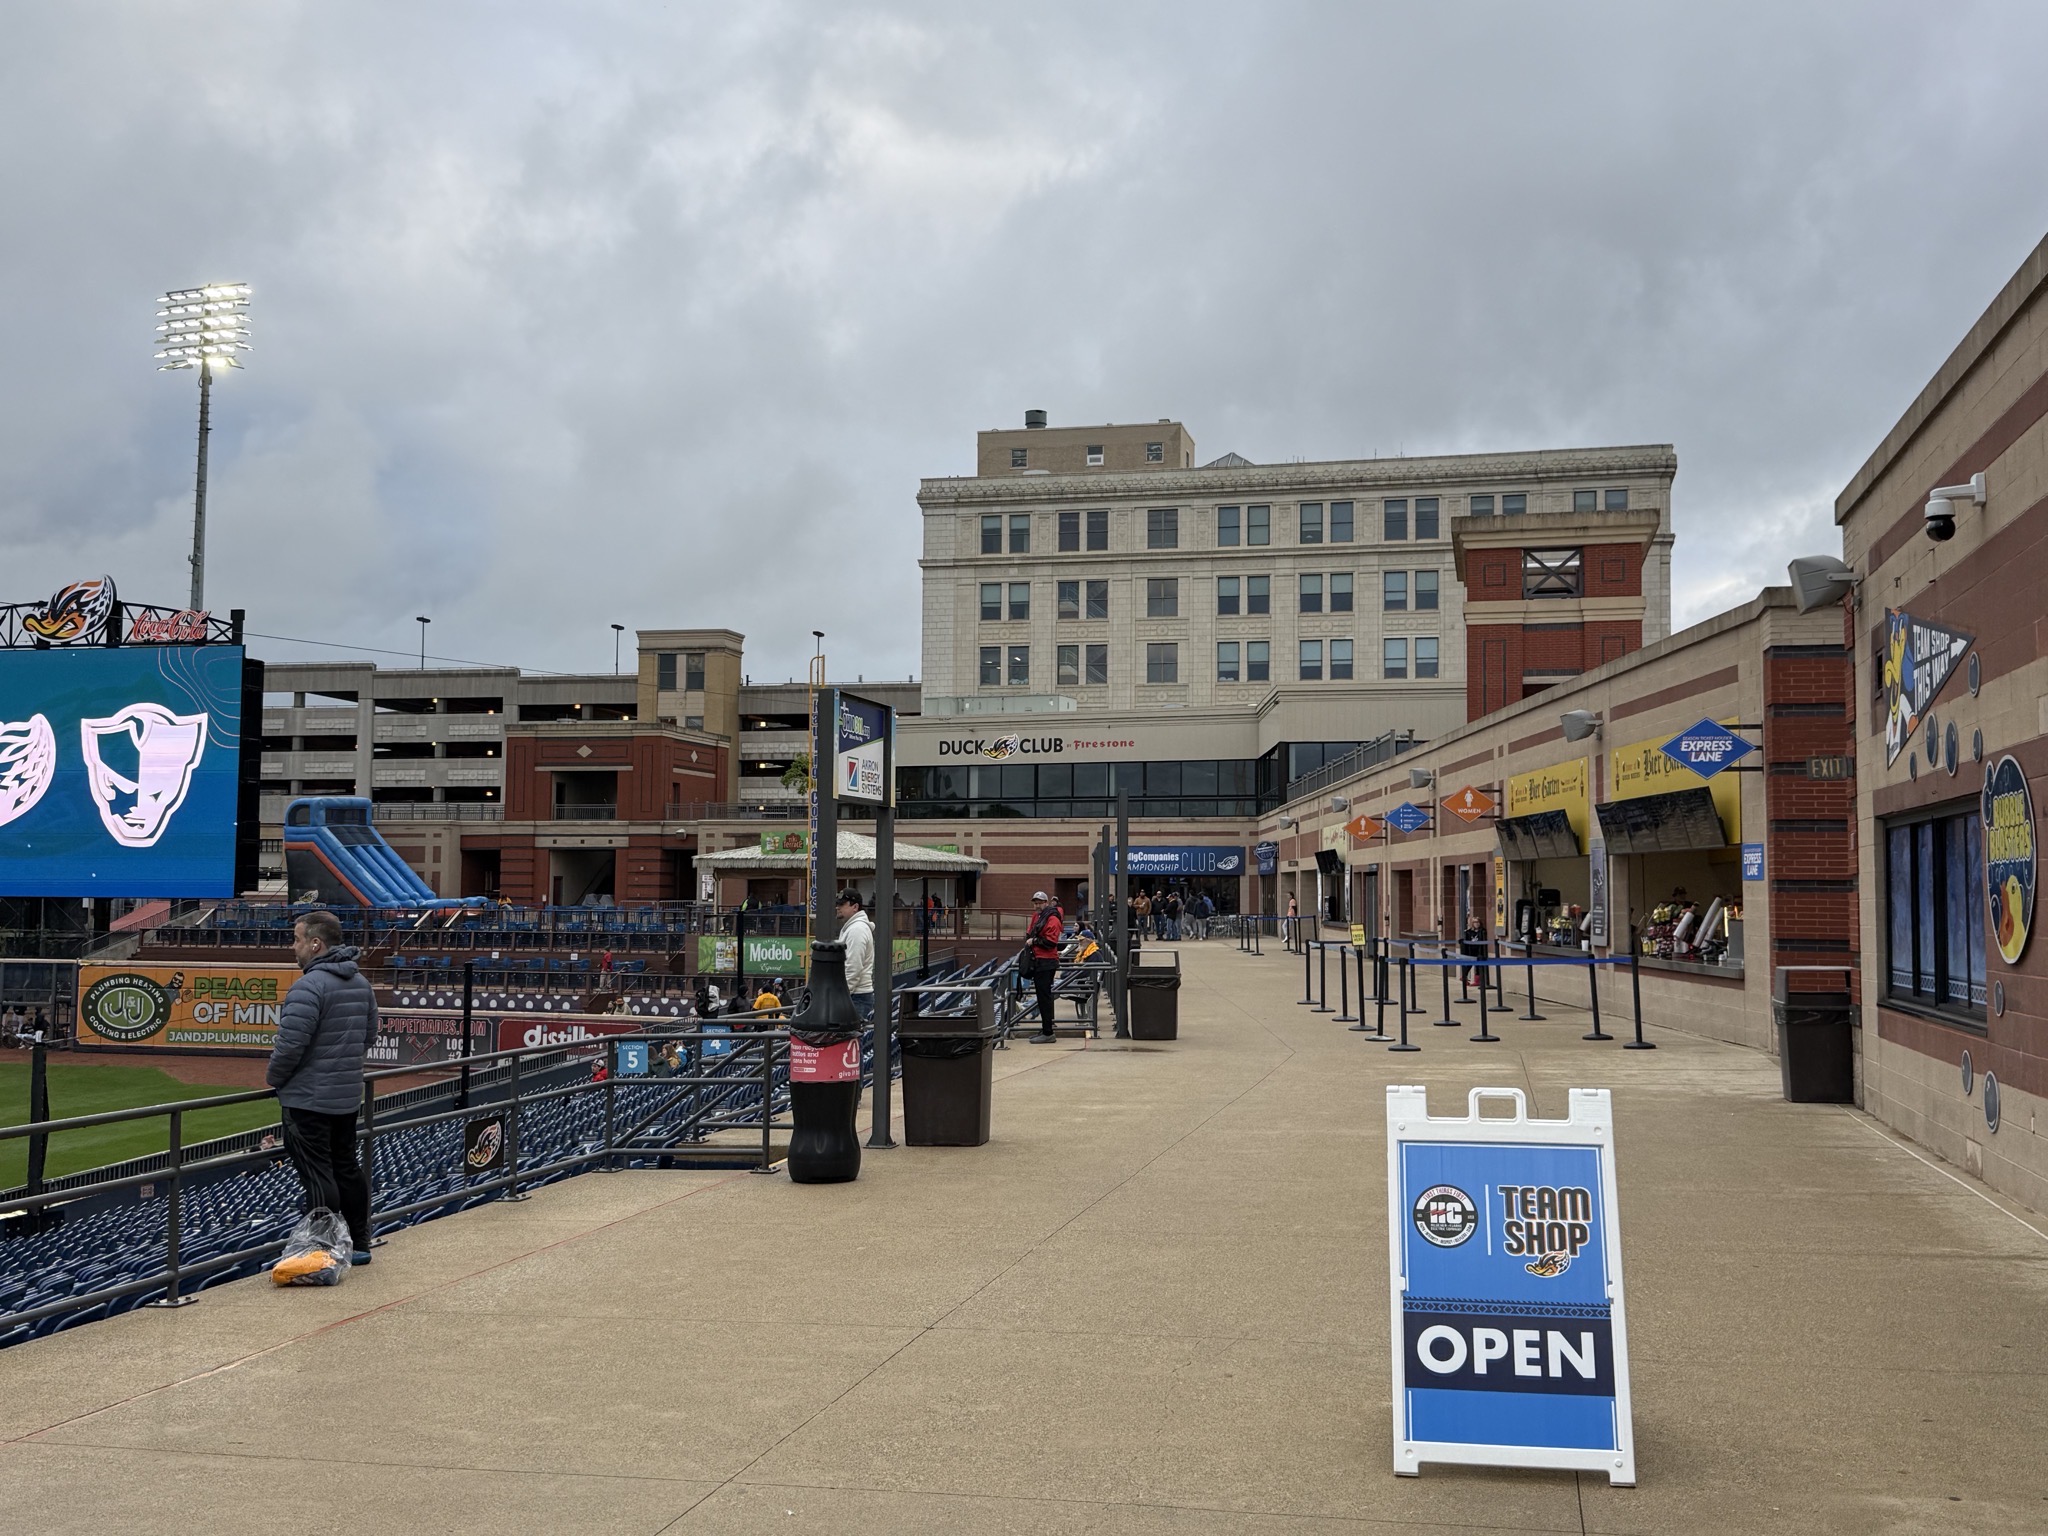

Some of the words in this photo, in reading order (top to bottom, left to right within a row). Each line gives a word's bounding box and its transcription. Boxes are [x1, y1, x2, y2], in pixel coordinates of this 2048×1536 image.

[133, 610, 208, 640] Coca-Cola
[1913, 624, 1931, 663] TEAM
[1931, 630, 1950, 655] SHOP
[1913, 661, 1931, 715] THIS
[1931, 651, 1950, 689] WAY
[939, 740, 985, 756] DUCK
[1019, 737, 1064, 754] CLUB
[1073, 739, 1135, 750] Firestone
[1680, 740, 1733, 751] EXPRESS
[861, 759, 879, 773] AKRON
[1690, 751, 1723, 762] LANE
[861, 771, 880, 784] ENERGY
[1811, 758, 1842, 778] EXIT
[861, 783, 882, 796] SYSTEMS
[1993, 789, 2026, 829] BUBBLE
[1990, 820, 2034, 865] BLASTERS
[1181, 852, 1216, 872] CLUB
[749, 943, 793, 962] Modelo
[90, 977, 131, 1001] PLUMBING
[132, 978, 164, 1004] HEATING
[194, 977, 278, 1000] PEACE
[193, 1002, 229, 1024] OF
[233, 1003, 283, 1026] MIN
[89, 1015, 120, 1039] COOLING
[127, 1017, 162, 1040] ELECTRIC
[389, 1036, 400, 1047] of
[446, 1038, 476, 1051] LOCL
[711, 1040, 721, 1050] 4
[366, 1047, 398, 1060] AKRON
[627, 1052, 639, 1068] 5
[838, 1069, 851, 1079] give
[1498, 1185, 1593, 1223] TEAM
[1503, 1220, 1590, 1258] SHOP
[1417, 1325, 1597, 1379] OPEN
